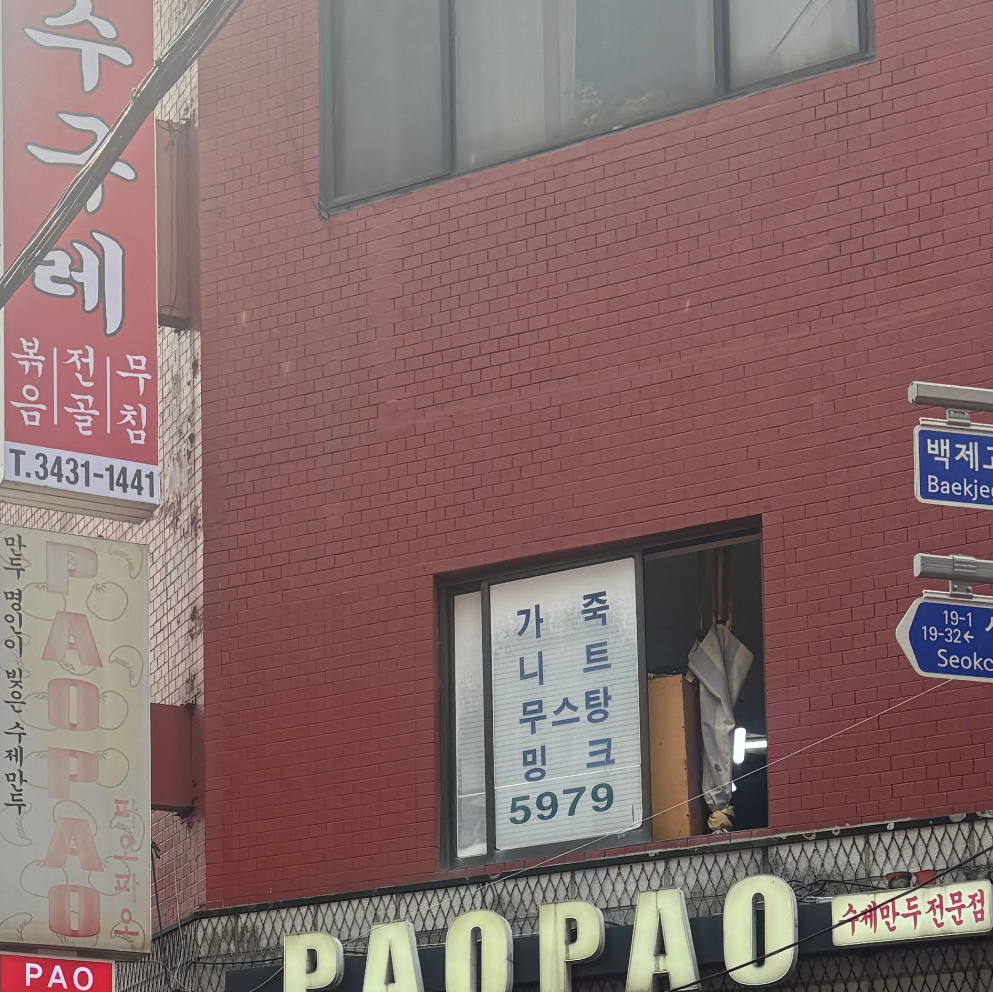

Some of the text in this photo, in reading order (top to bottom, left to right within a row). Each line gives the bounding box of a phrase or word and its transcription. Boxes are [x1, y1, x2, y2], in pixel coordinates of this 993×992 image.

[10, 336, 47, 427] 볶음
[62, 344, 100, 437] 전골
[116, 353, 152, 446] 무침
[9, 448, 156, 499] T.3431-1441
[921, 625, 962, 644] 19-32
[943, 609, 972, 628] 19-1
[3, 534, 27, 817] 만두 명인이 빚은 수제만두
[518, 686, 613, 735] 무스탕
[40, 541, 104, 938] PAOPAO
[509, 782, 615, 825] 5979
[925, 888, 986, 929] 전문점
[24, 963, 94, 992] PAO
